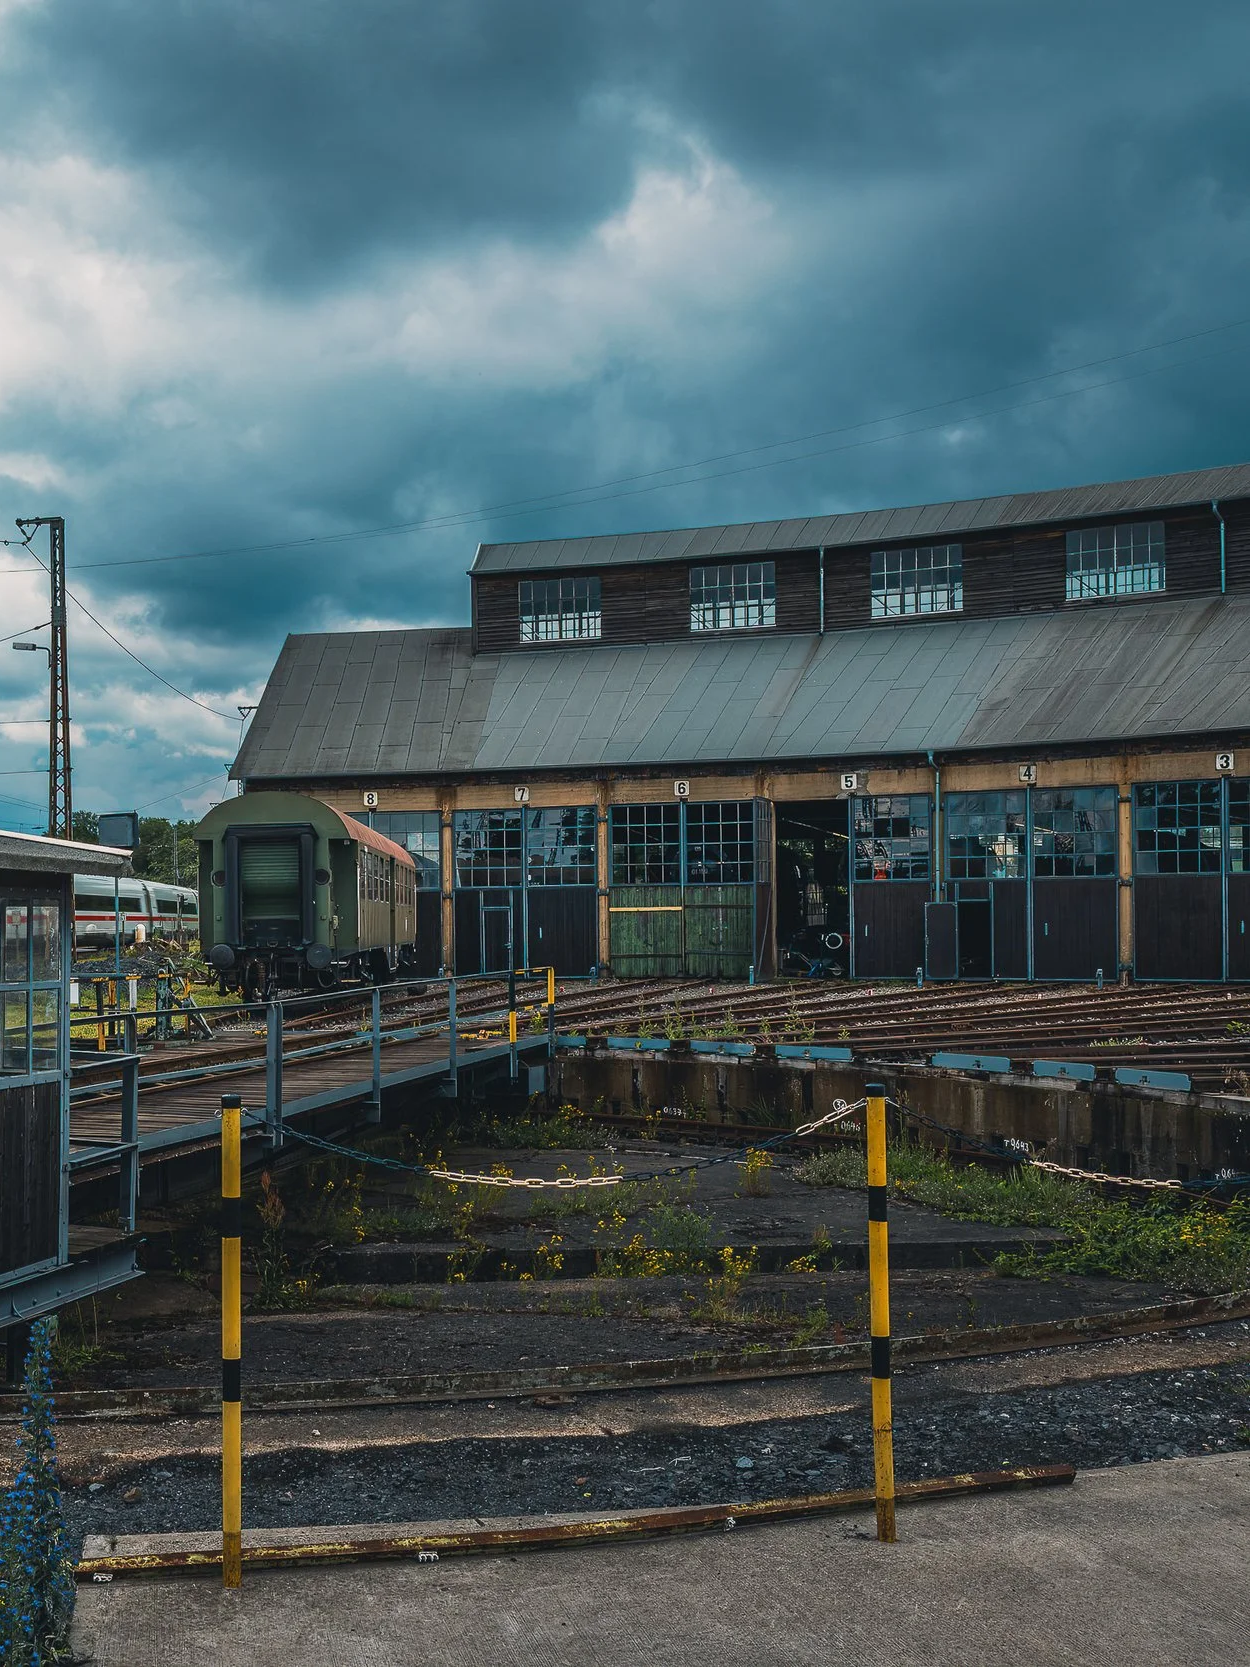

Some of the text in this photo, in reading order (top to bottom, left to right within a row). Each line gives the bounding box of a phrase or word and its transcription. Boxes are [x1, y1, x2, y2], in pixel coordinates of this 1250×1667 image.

[1220, 754, 1230, 769] 3
[1023, 765, 1033, 780] 4
[844, 775, 853, 788] 5
[517, 787, 526, 800] 7
[677, 782, 686, 795] 6
[366, 793, 375, 805] 8
